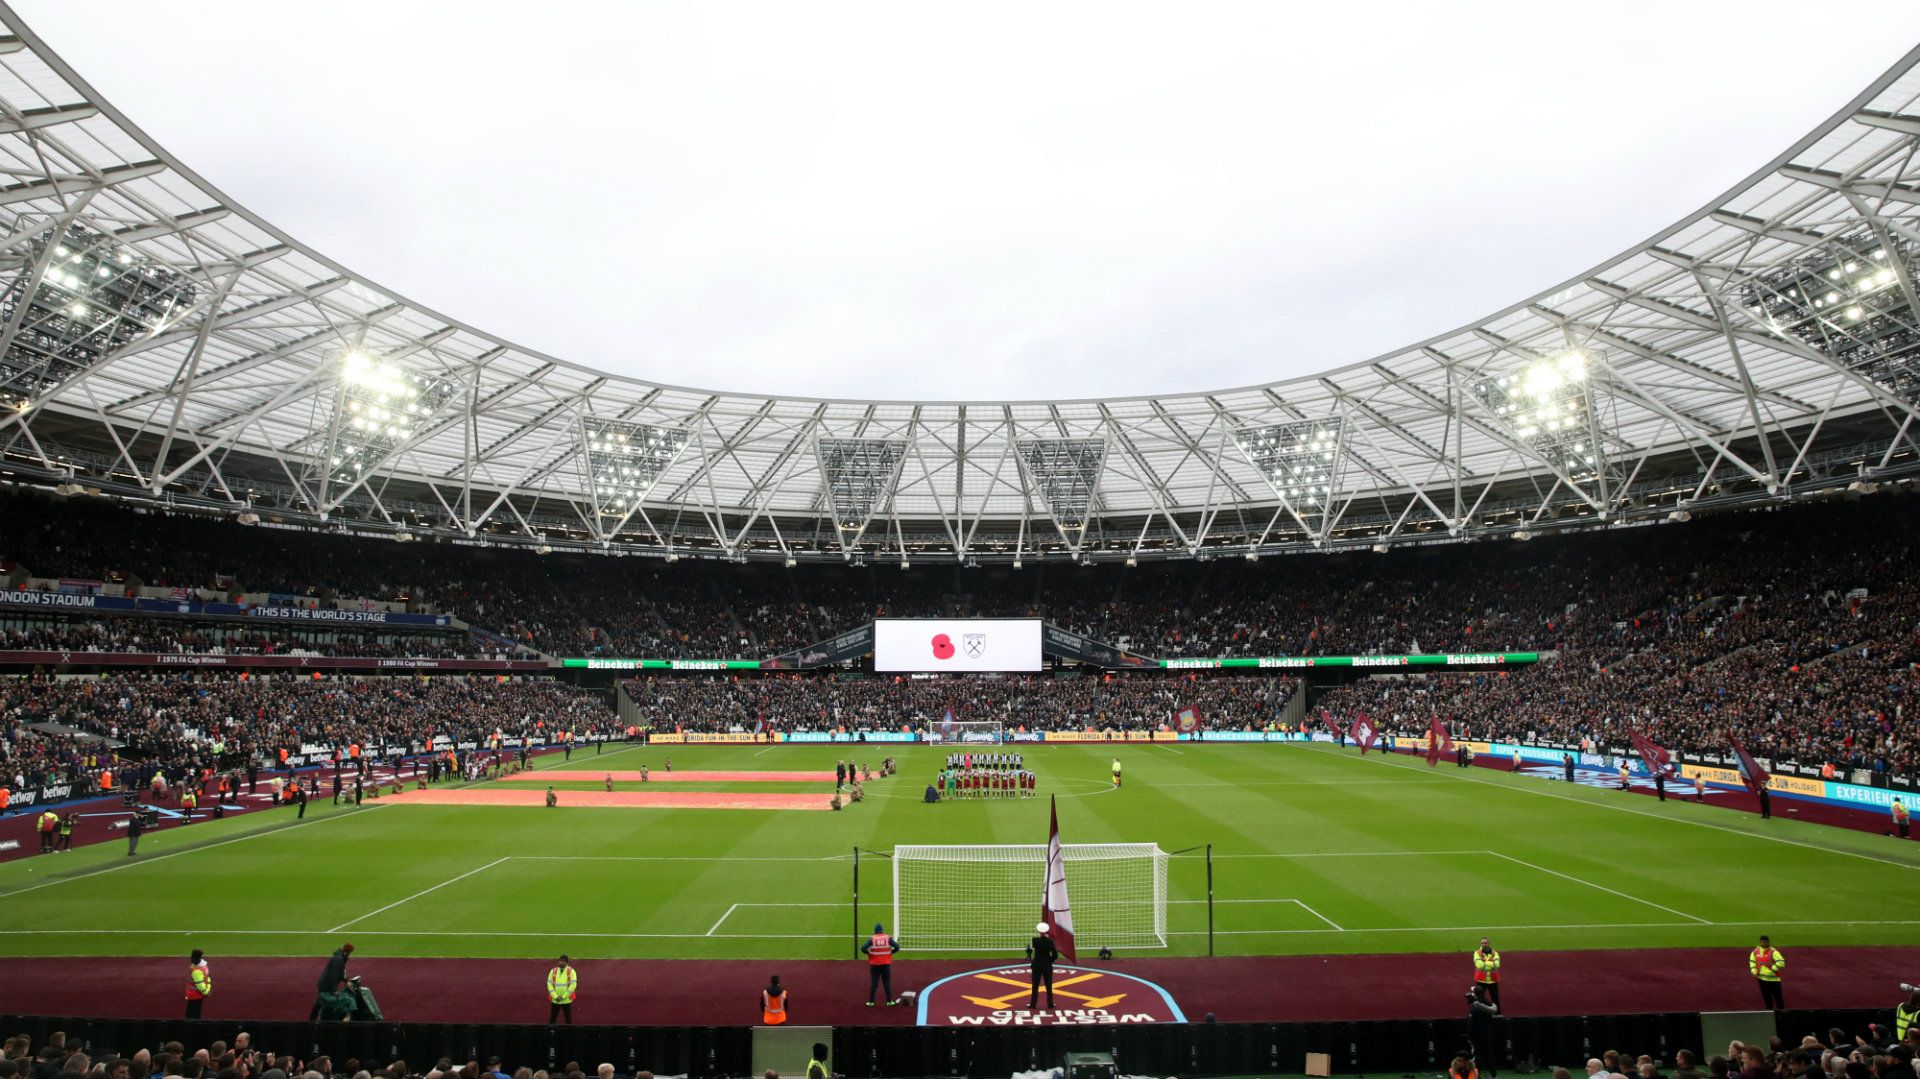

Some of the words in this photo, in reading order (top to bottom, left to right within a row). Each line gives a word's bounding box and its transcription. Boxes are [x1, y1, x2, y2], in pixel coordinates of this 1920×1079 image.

[42, 593, 95, 607] STADIUM
[257, 606, 279, 617] THIS
[280, 608, 289, 618] IS
[292, 608, 310, 618] THE
[312, 610, 354, 620] WORLD'S
[356, 612, 386, 622] STAGE
[188, 657, 200, 665] Cup
[588, 659, 635, 669] Heineken
[1166, 660, 1214, 668] Heineken
[1259, 658, 1306, 667] Heineken
[1352, 656, 1400, 666] Heineken
[1447, 654, 1496, 664] Heineken
[672, 660, 719, 669] Heineken
[458, 741, 477, 750] betway
[386, 746, 407, 756] betway
[285, 755, 306, 766] etway
[1776, 762, 1796, 774] betway
[1800, 765, 1820, 777] betway
[1713, 770, 1737, 783] FLORIDA
[43, 785, 72, 799] betway
[998, 968, 1077, 976] LOON
[992, 1008, 1109, 1018] UNITED
[948, 1015, 1042, 1025] HAM
[1052, 1013, 1156, 1025] WEST
